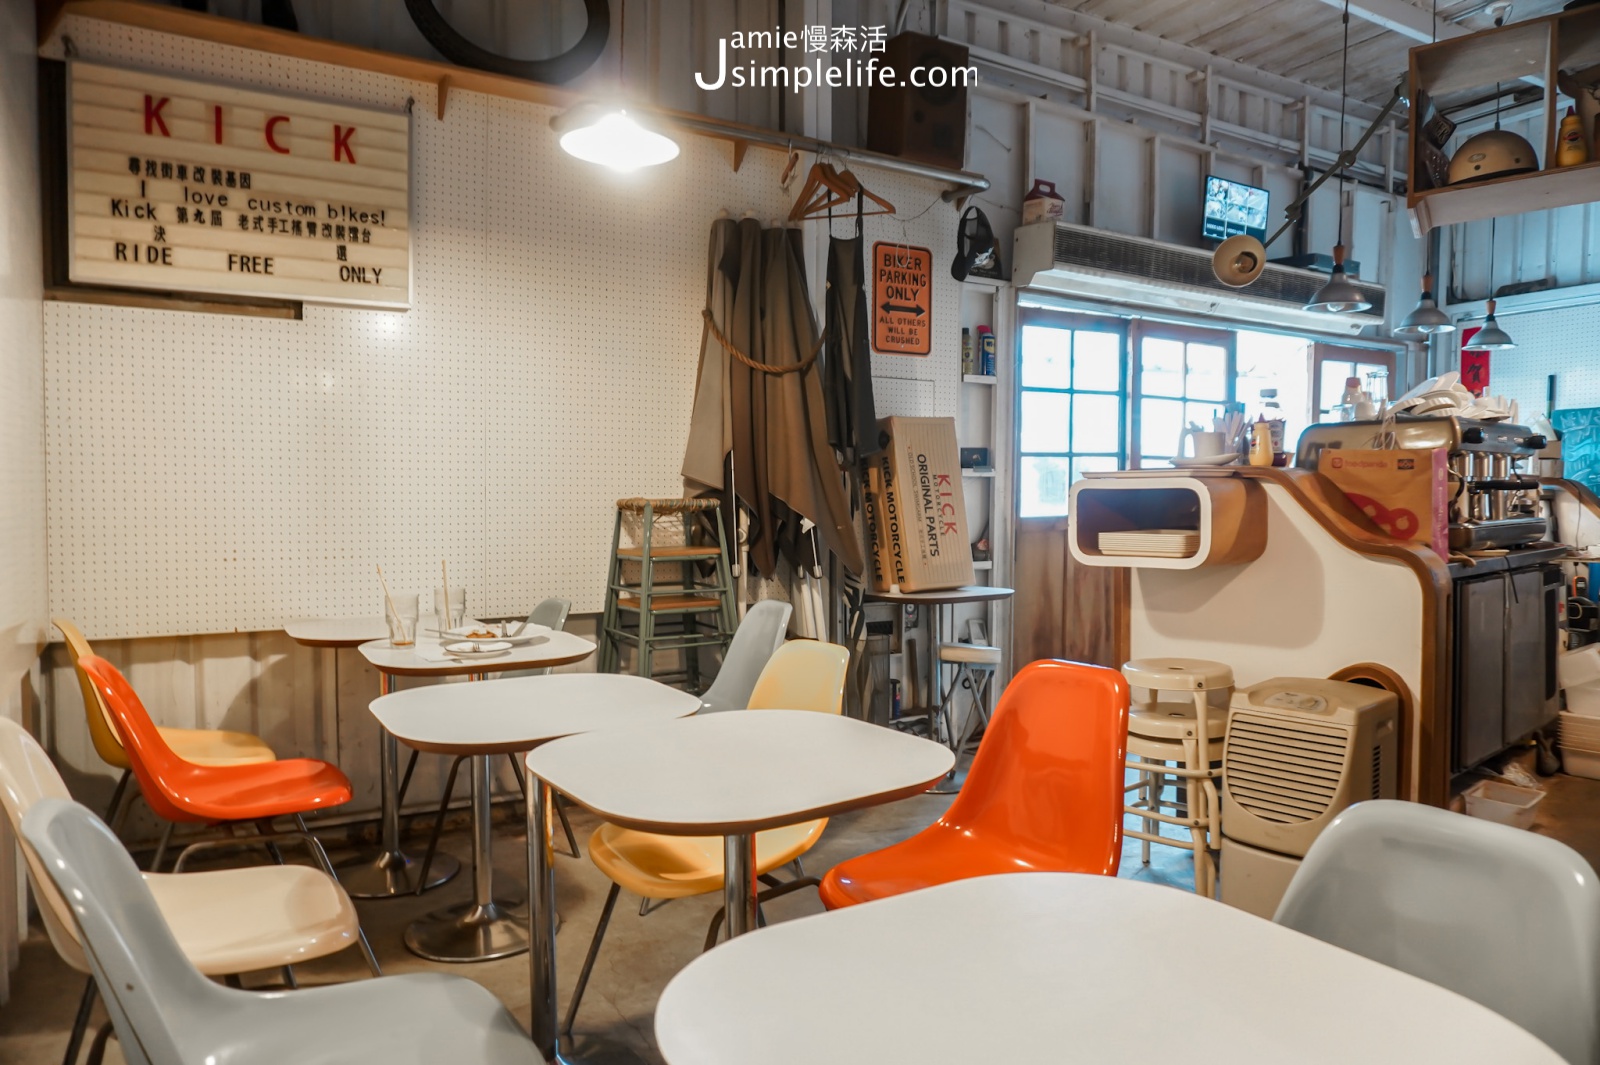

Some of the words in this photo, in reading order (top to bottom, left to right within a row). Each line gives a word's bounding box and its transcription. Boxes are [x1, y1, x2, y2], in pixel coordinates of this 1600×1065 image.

[144, 95, 357, 164] KICK
[111, 199, 157, 221] Kick
[176, 206, 222, 227] 第九屆
[184, 186, 228, 207] love
[248, 198, 316, 217] custom
[115, 242, 173, 266] RIDE
[228, 253, 274, 275] FREE
[339, 265, 382, 284] ONLY
[880, 269, 926, 287] PARKING
[884, 253, 922, 271] BIKER
[886, 286, 920, 301] ONLY
[879, 316, 895, 325] ALL
[897, 317, 926, 327] OTHERS
[887, 326, 905, 335] WILL
[908, 328, 918, 336] BE
[885, 335, 920, 345] CRUSHED
[882, 456, 892, 489] KICK
[917, 453, 934, 513] ORIGINAL
[933, 474, 945, 536] MOTORCYCLE
[937, 474, 957, 534] KICK
[865, 492, 883, 582] MOTORCYCLE
[886, 492, 905, 583] MOTORCYCLE
[925, 516, 940, 557] PARTS
